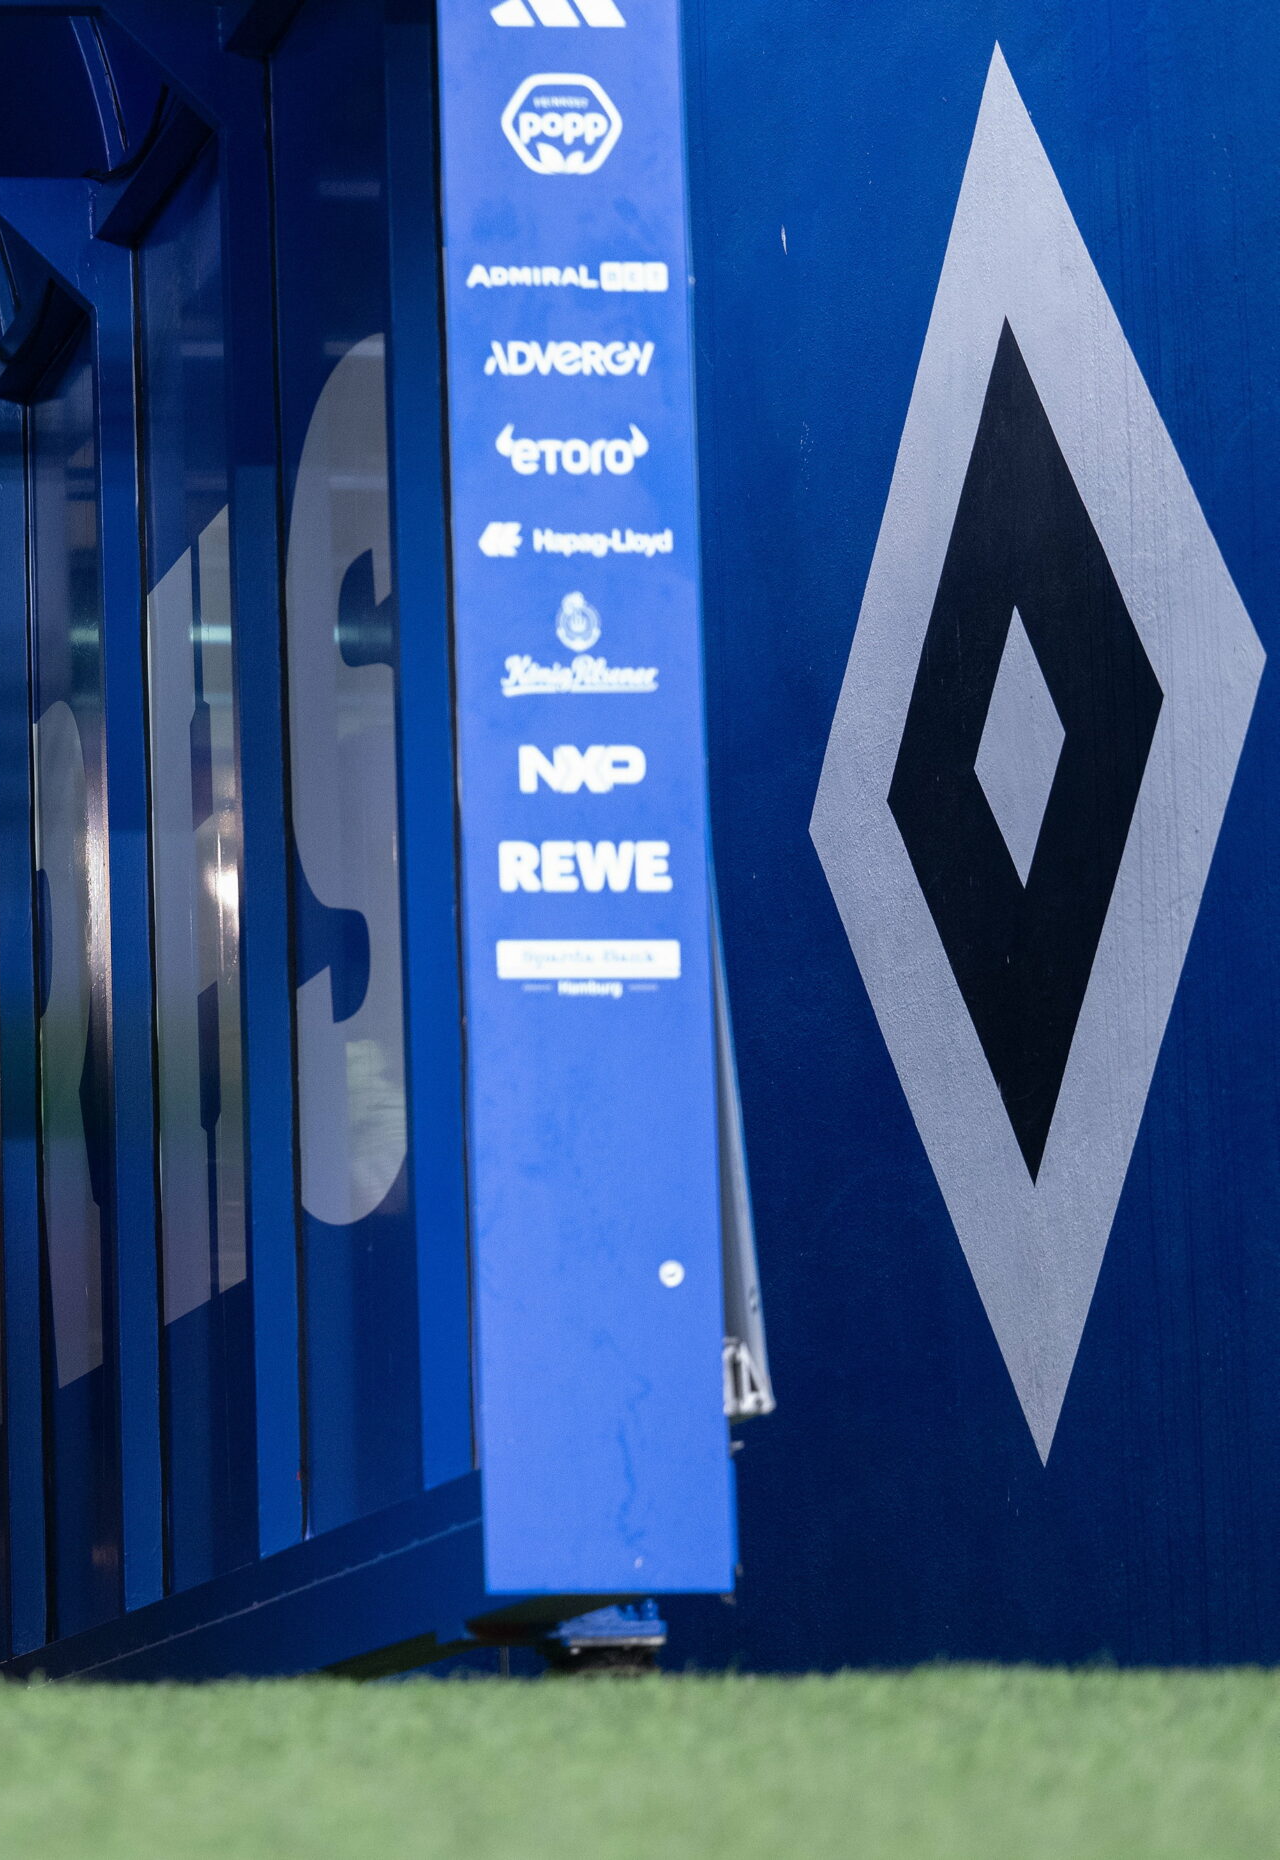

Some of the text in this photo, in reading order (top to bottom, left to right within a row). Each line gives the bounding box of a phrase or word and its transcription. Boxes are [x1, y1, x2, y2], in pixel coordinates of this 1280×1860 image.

[519, 112, 608, 146] popp
[466, 264, 599, 289] ADMIRAL
[518, 744, 647, 794] NXP
[498, 840, 673, 893] REWE
